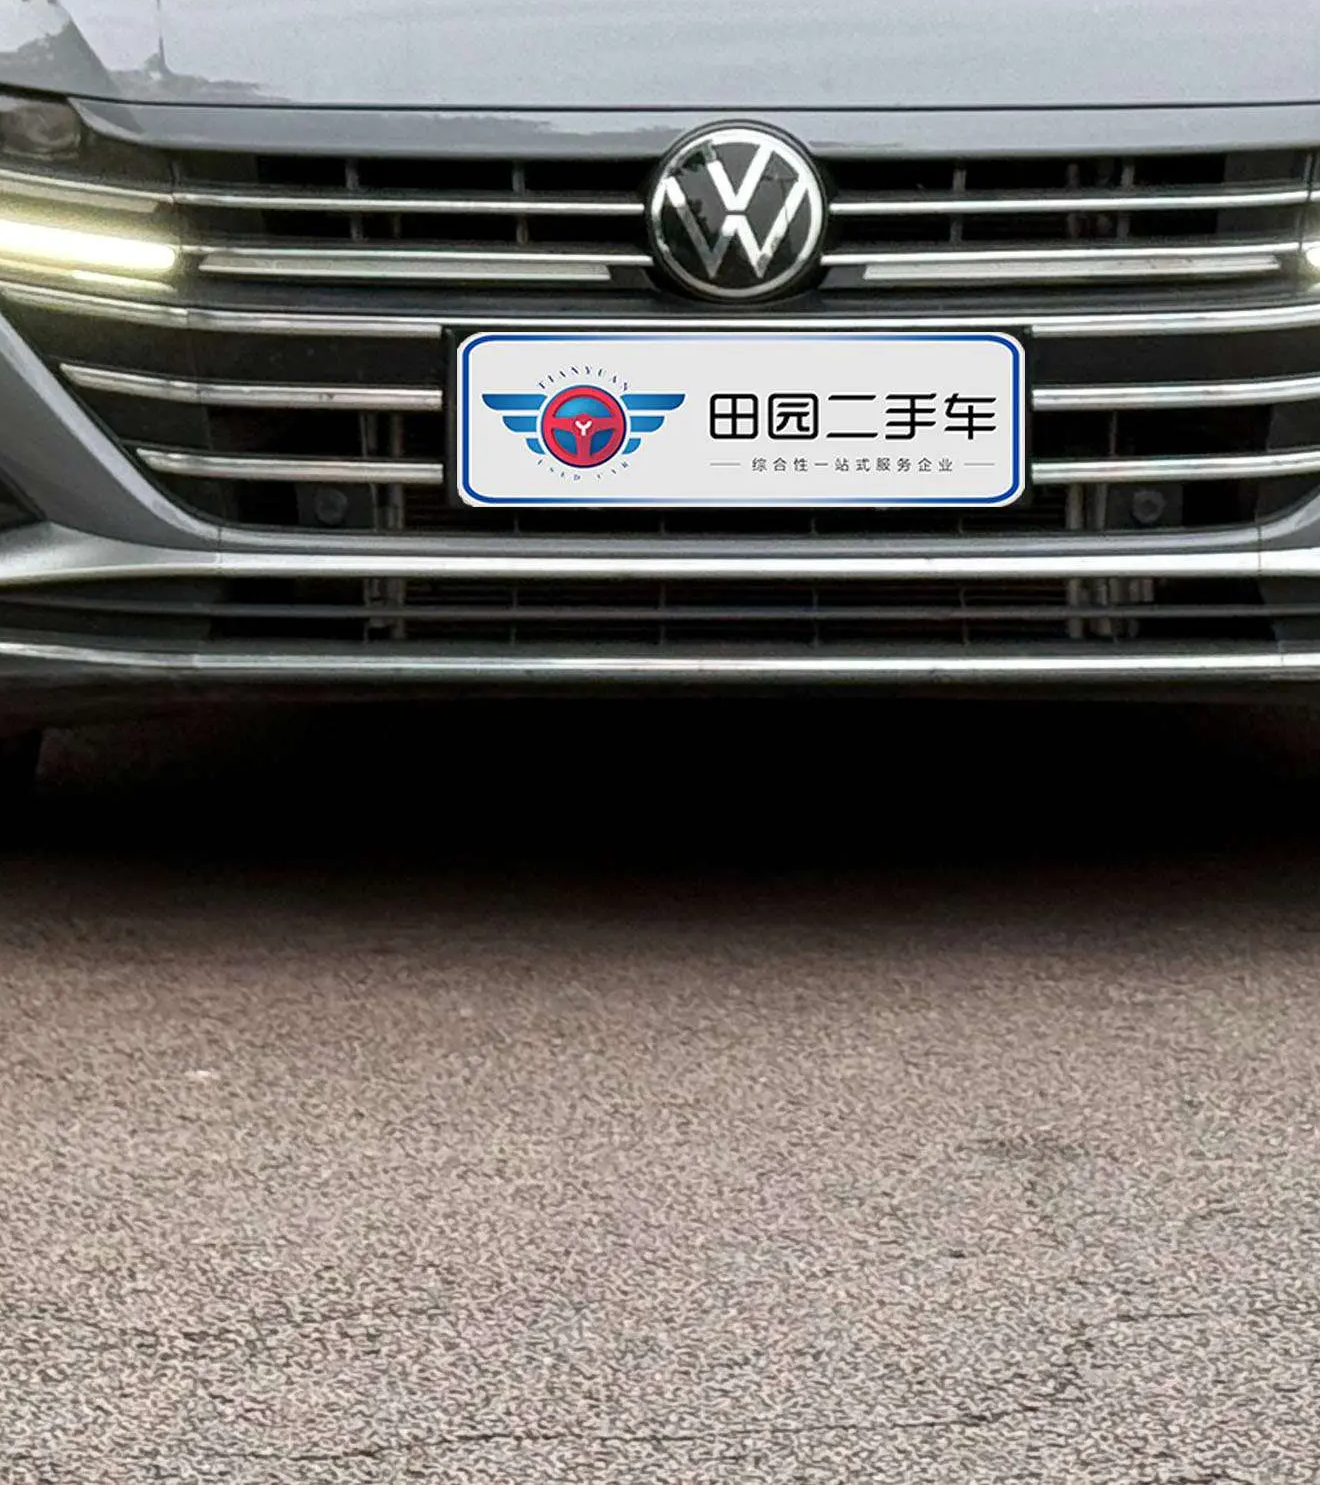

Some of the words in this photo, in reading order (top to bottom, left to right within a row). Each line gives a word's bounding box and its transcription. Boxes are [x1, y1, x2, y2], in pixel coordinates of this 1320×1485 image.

[709, 392, 997, 440] 田园二手车
[751, 457, 953, 473] 综合性一站式服务企业
